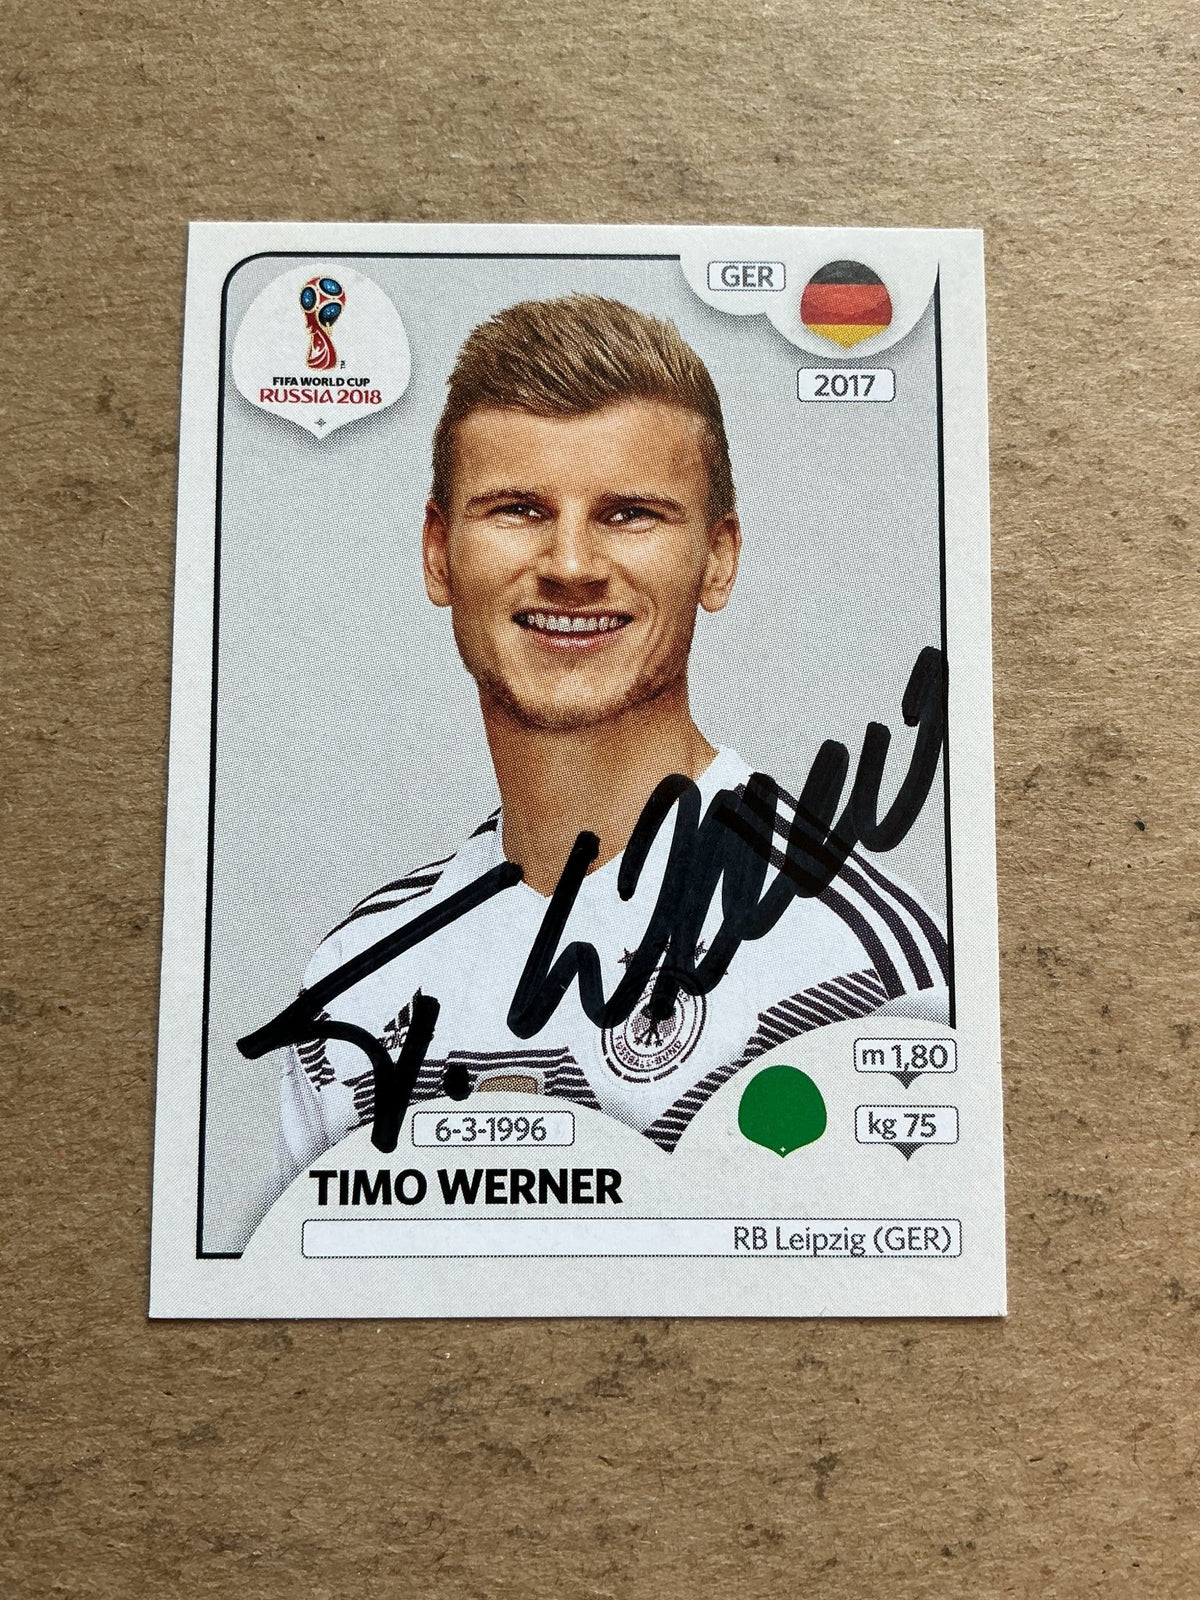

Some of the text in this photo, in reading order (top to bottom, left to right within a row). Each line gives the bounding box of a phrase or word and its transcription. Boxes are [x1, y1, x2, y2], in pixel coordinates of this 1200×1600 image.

[720, 264, 774, 288] GER
[272, 376, 371, 388] FIFA WORLD CUP
[814, 374, 876, 397] 2017
[259, 388, 383, 405] RUSSIA 2018
[861, 1043, 949, 1071] m 1,80
[435, 1116, 548, 1143] 6-3-1996
[868, 1111, 937, 1141] kg 75
[309, 1168, 624, 1206] TIMO WERNER
[733, 1225, 952, 1258] RB Leipzig (GER)
